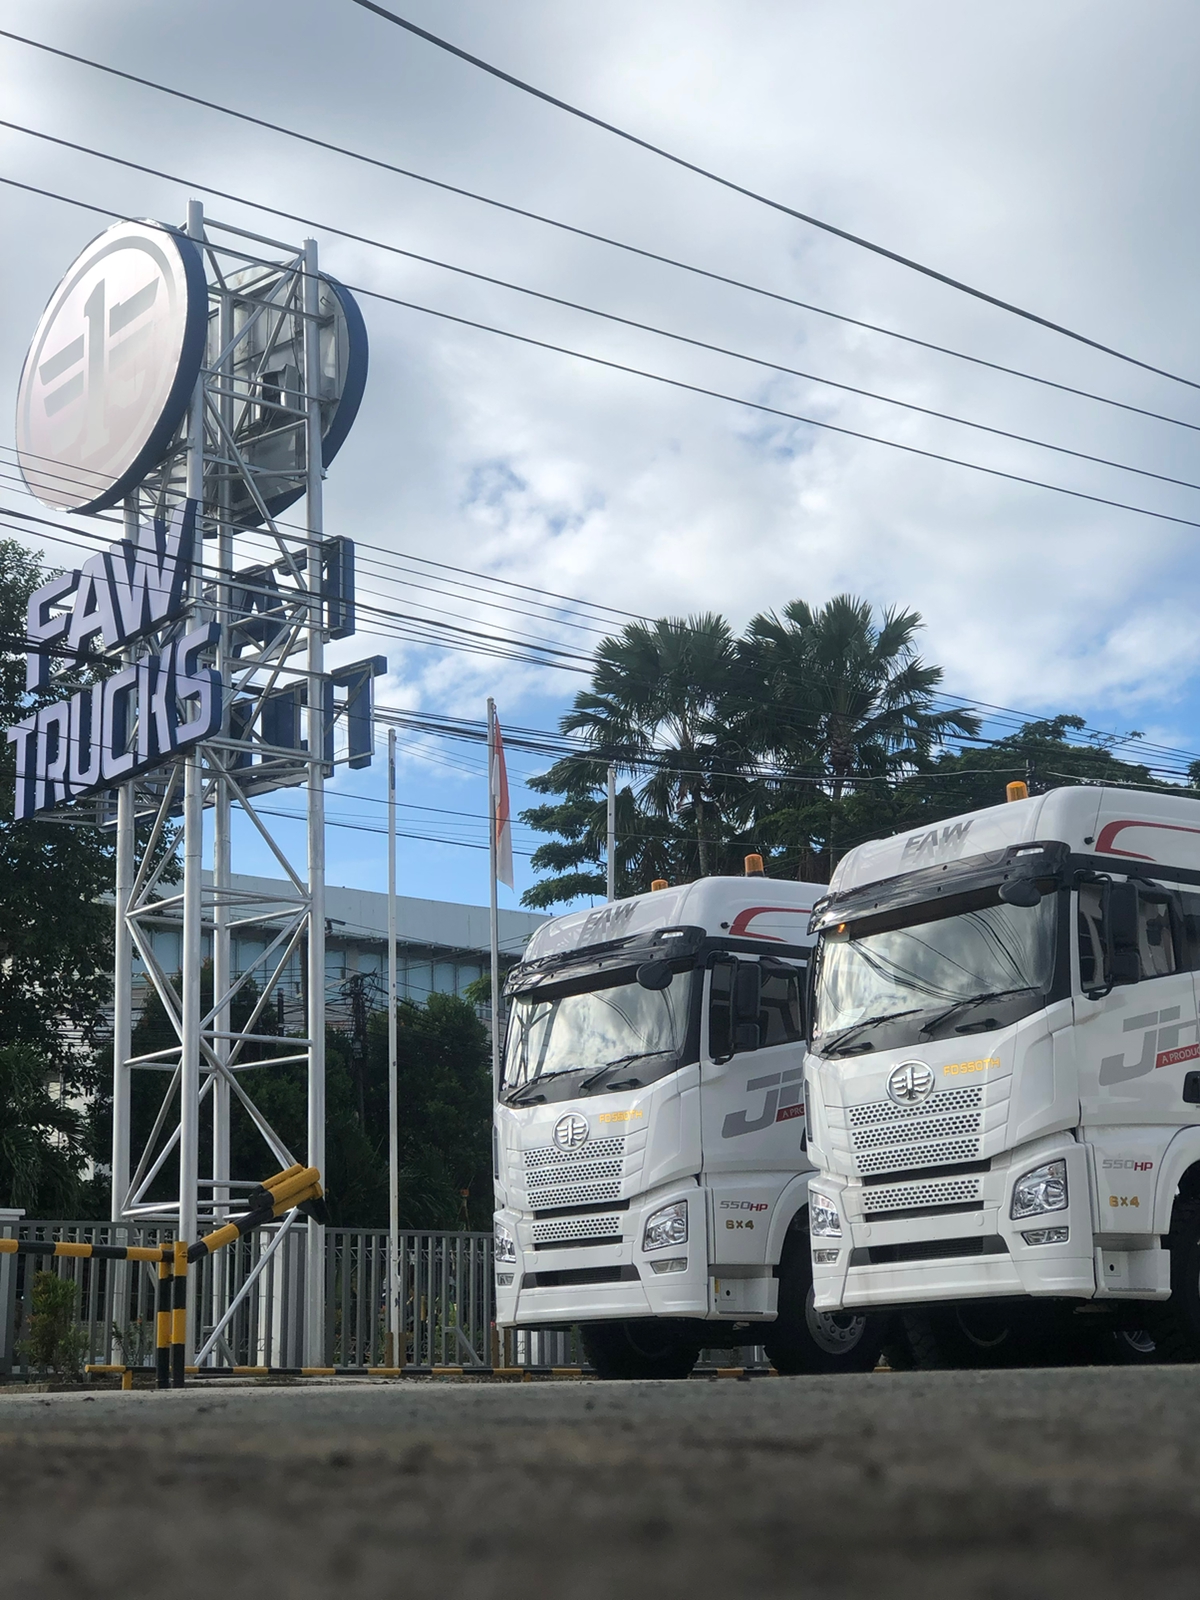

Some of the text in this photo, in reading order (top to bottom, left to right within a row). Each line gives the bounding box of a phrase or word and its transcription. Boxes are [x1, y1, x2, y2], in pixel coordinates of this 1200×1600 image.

[26, 498, 198, 692] FAW
[7, 622, 222, 821] TRUCKS
[901, 819, 975, 860] FAW
[1101, 1159, 1154, 1171] 550HP
[719, 1201, 769, 1212] 550HP
